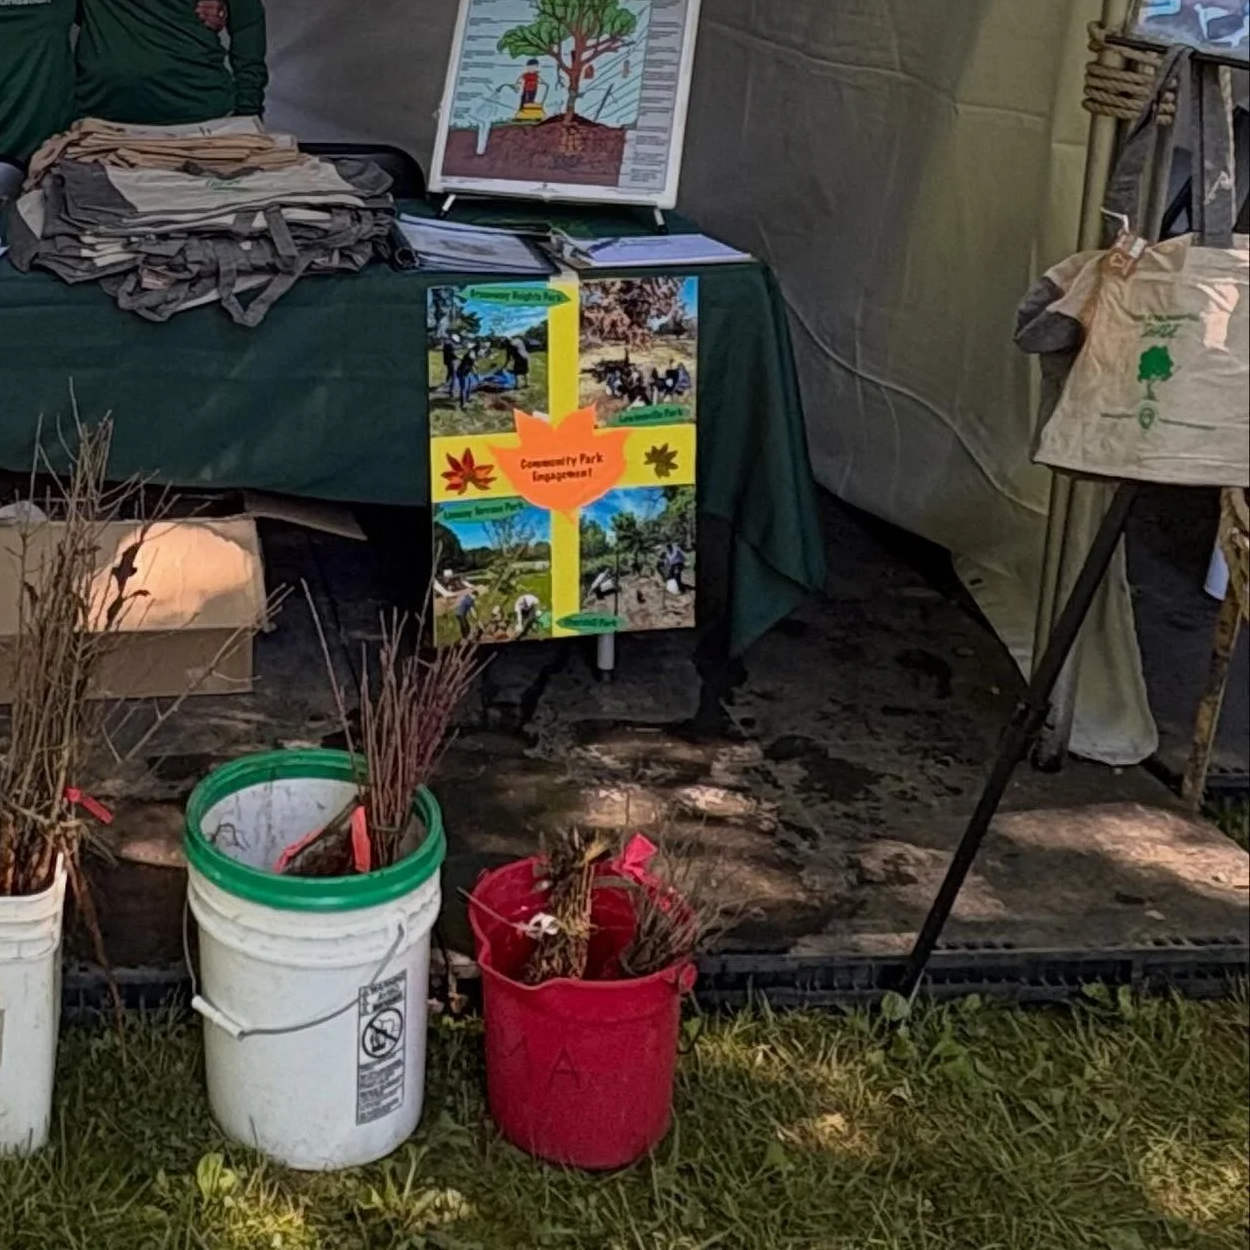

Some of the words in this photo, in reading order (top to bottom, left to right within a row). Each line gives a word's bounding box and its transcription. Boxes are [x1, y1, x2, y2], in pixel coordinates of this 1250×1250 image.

[520, 456, 578, 470] Community
[579, 452, 605, 465] Park
[532, 467, 593, 484] Engagement
